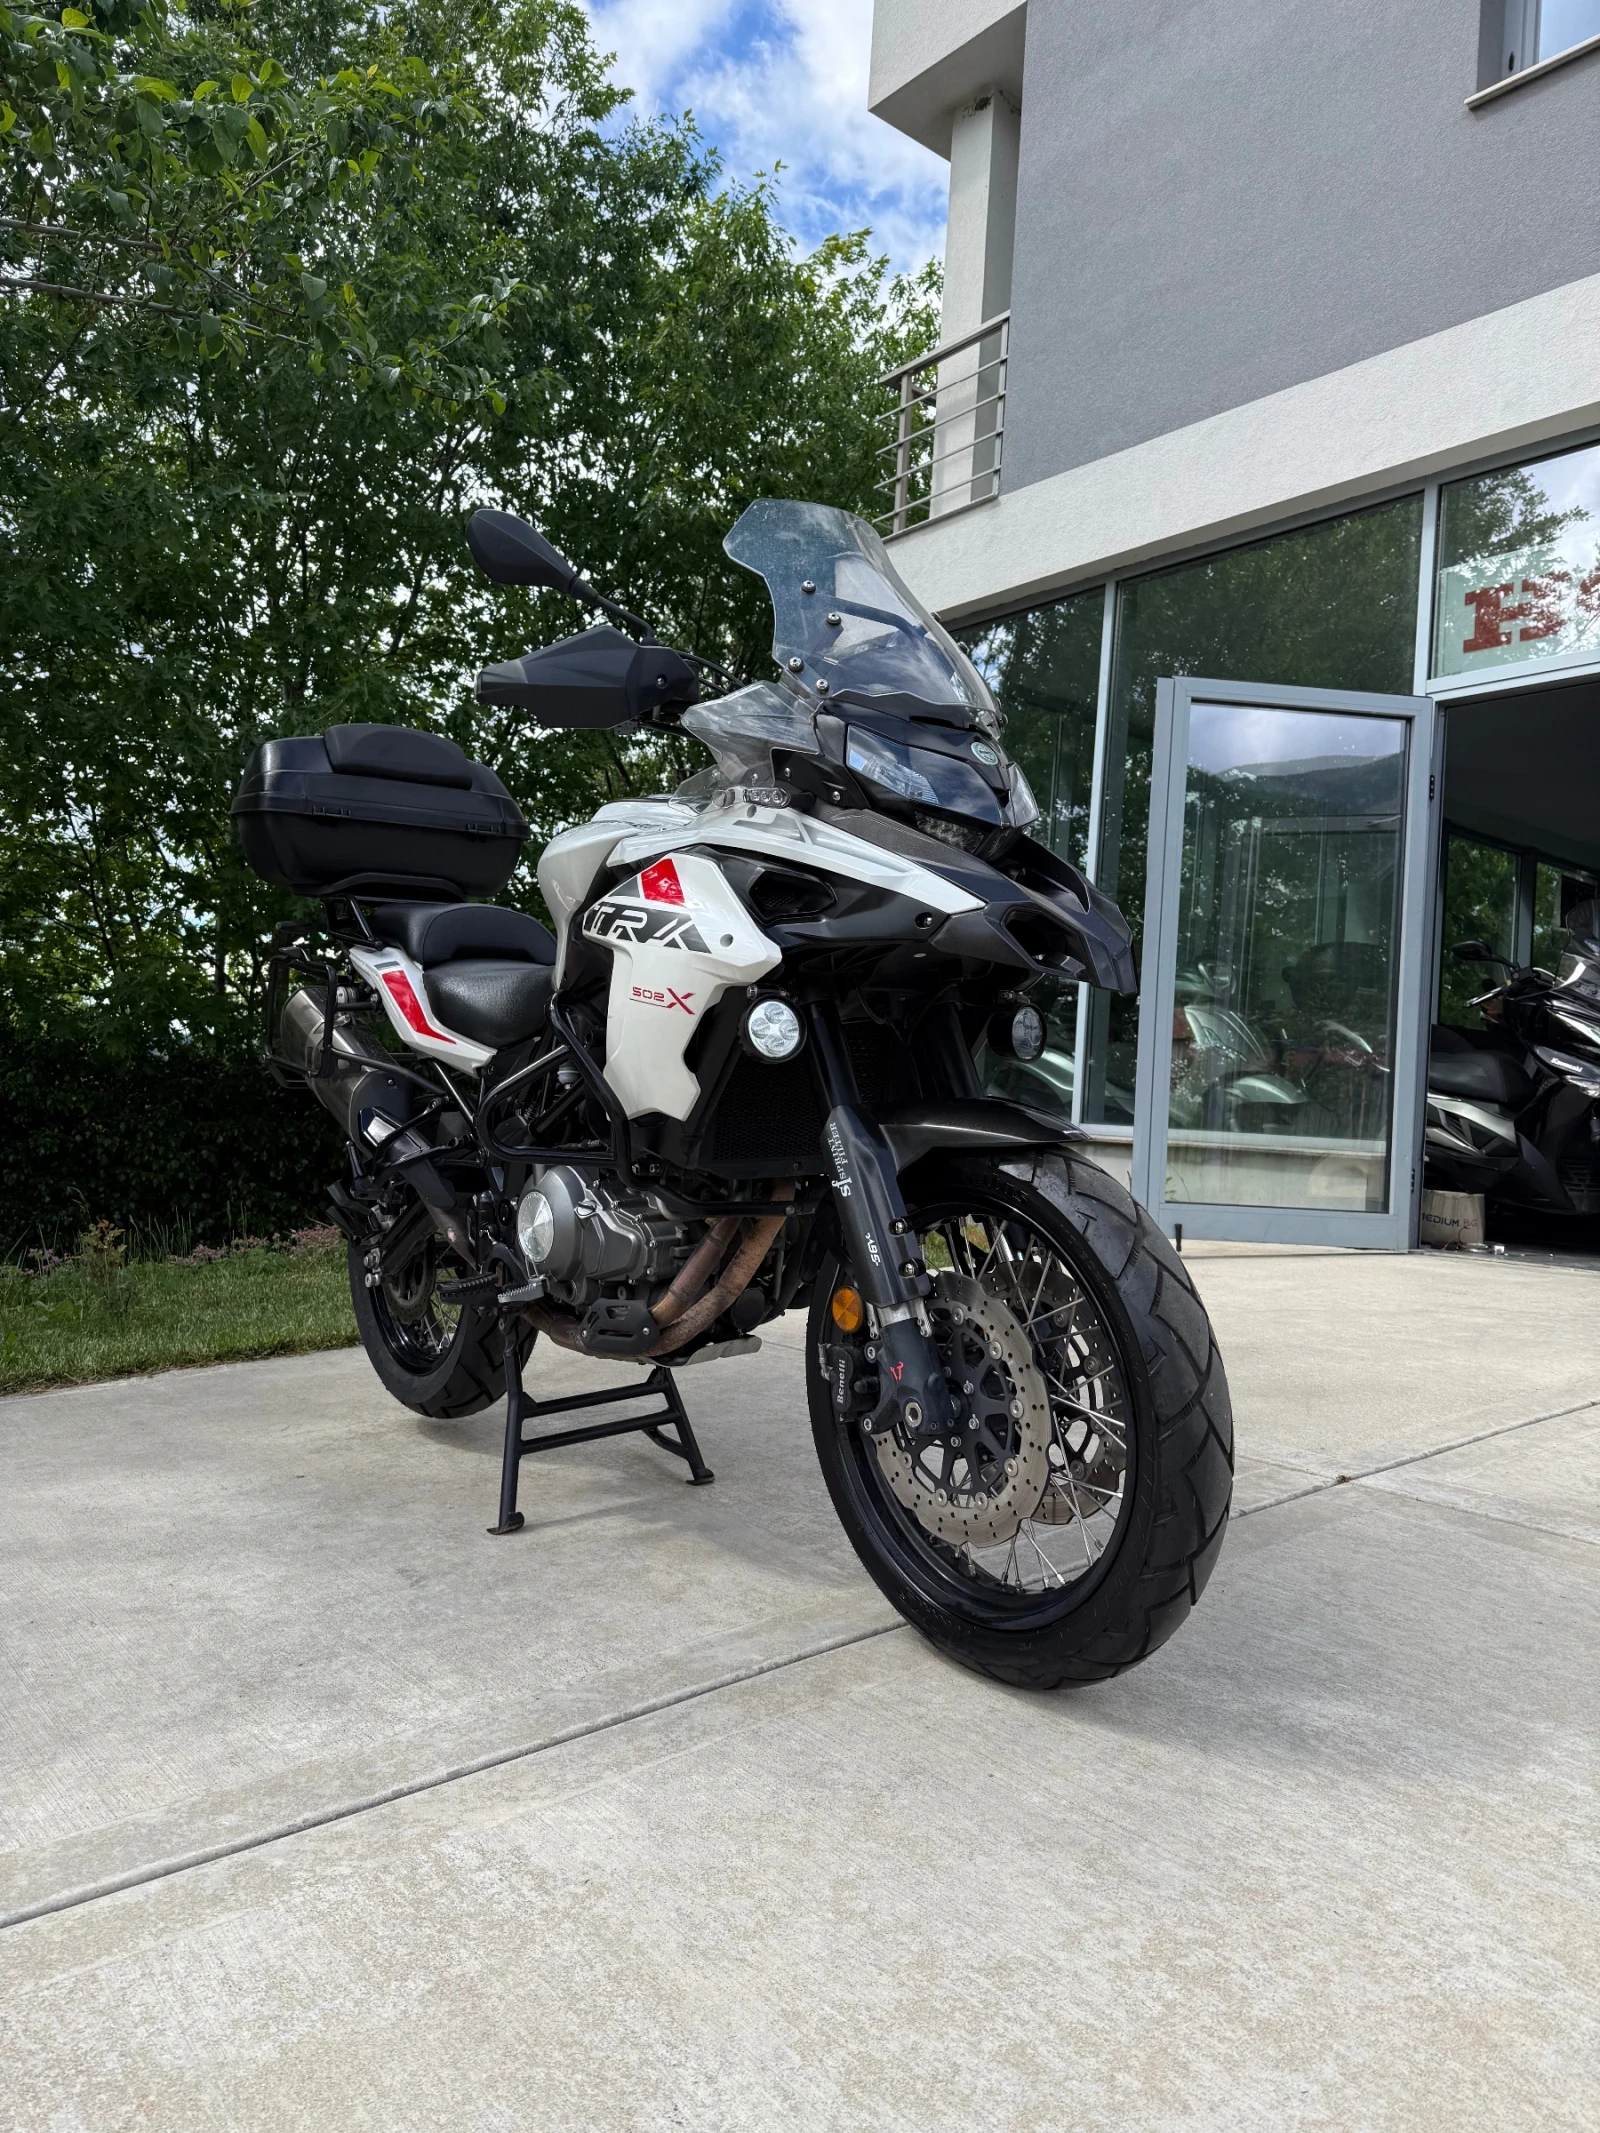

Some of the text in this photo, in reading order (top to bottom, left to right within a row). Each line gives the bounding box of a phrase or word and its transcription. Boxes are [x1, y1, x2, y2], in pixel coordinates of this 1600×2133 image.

[590, 903, 696, 951] TRK
[828, 1137, 847, 1180] SPRINT
[829, 1121, 849, 1165] FILTER
[866, 1232, 882, 1267] ABS
[836, 1359, 847, 1404] Benelli
